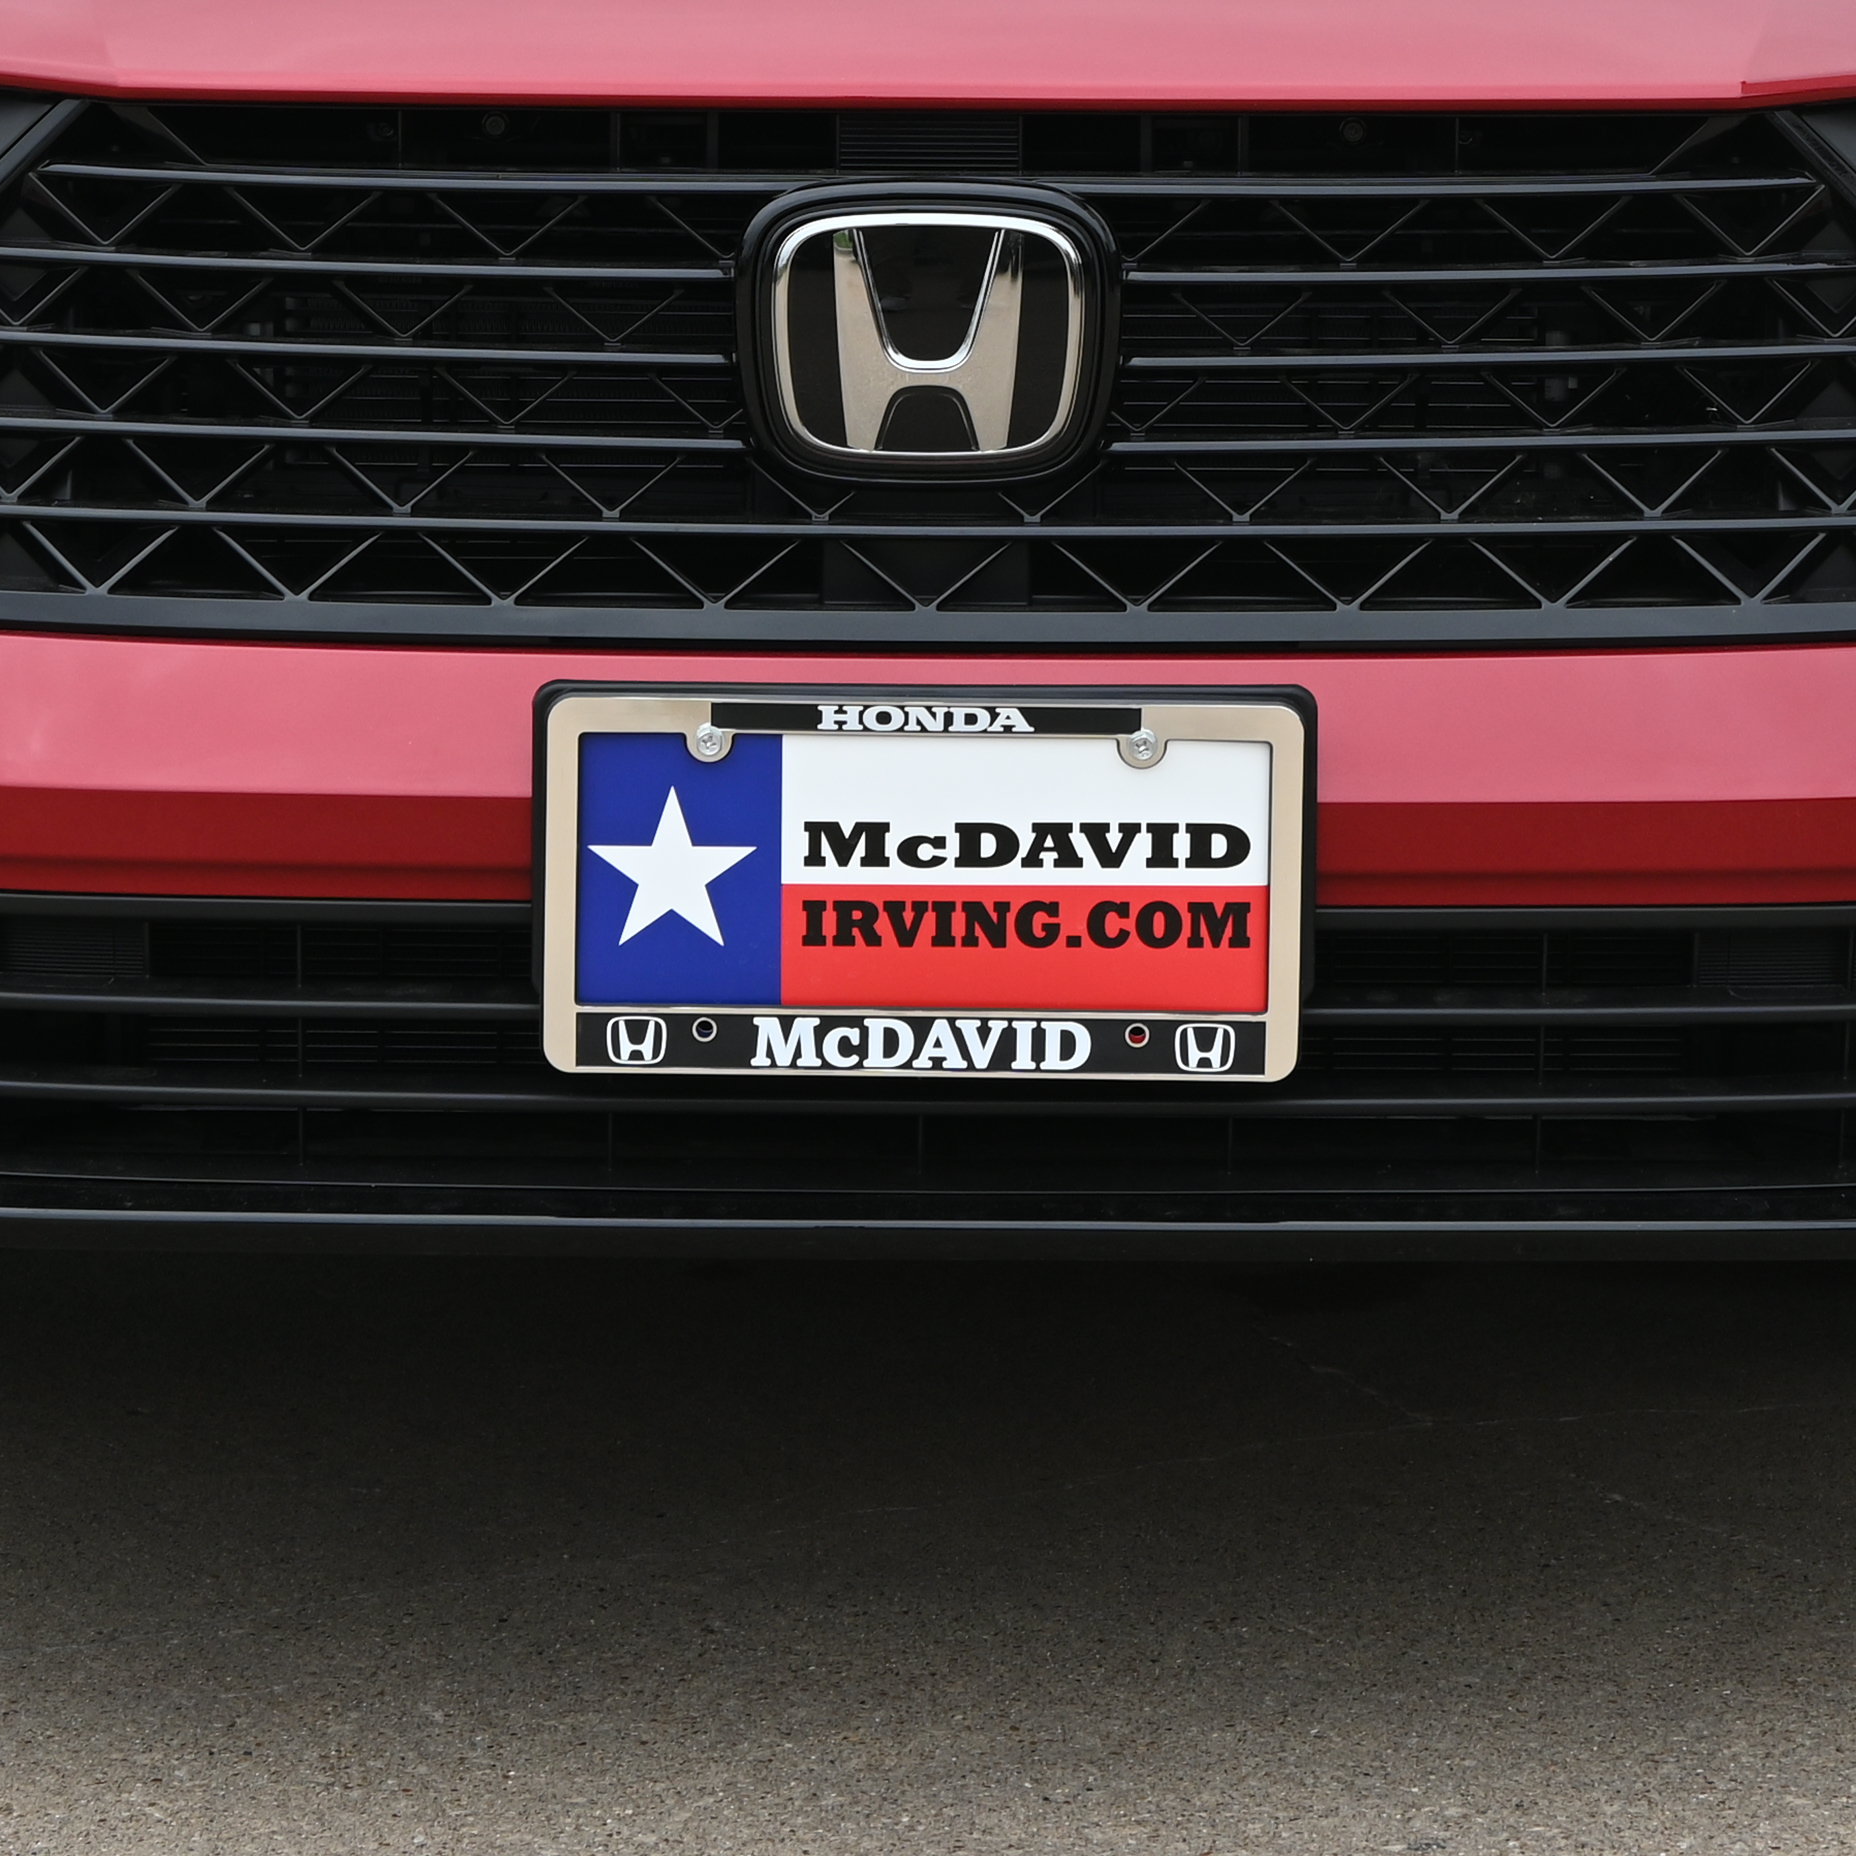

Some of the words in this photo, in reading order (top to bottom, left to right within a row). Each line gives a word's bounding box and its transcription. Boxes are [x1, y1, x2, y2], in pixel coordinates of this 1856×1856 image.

[817, 705, 1035, 733] HONDA
[803, 821, 1252, 869] McDAVID
[801, 899, 1251, 949] IRVING.COM
[750, 1016, 1092, 1071] McDAVID
